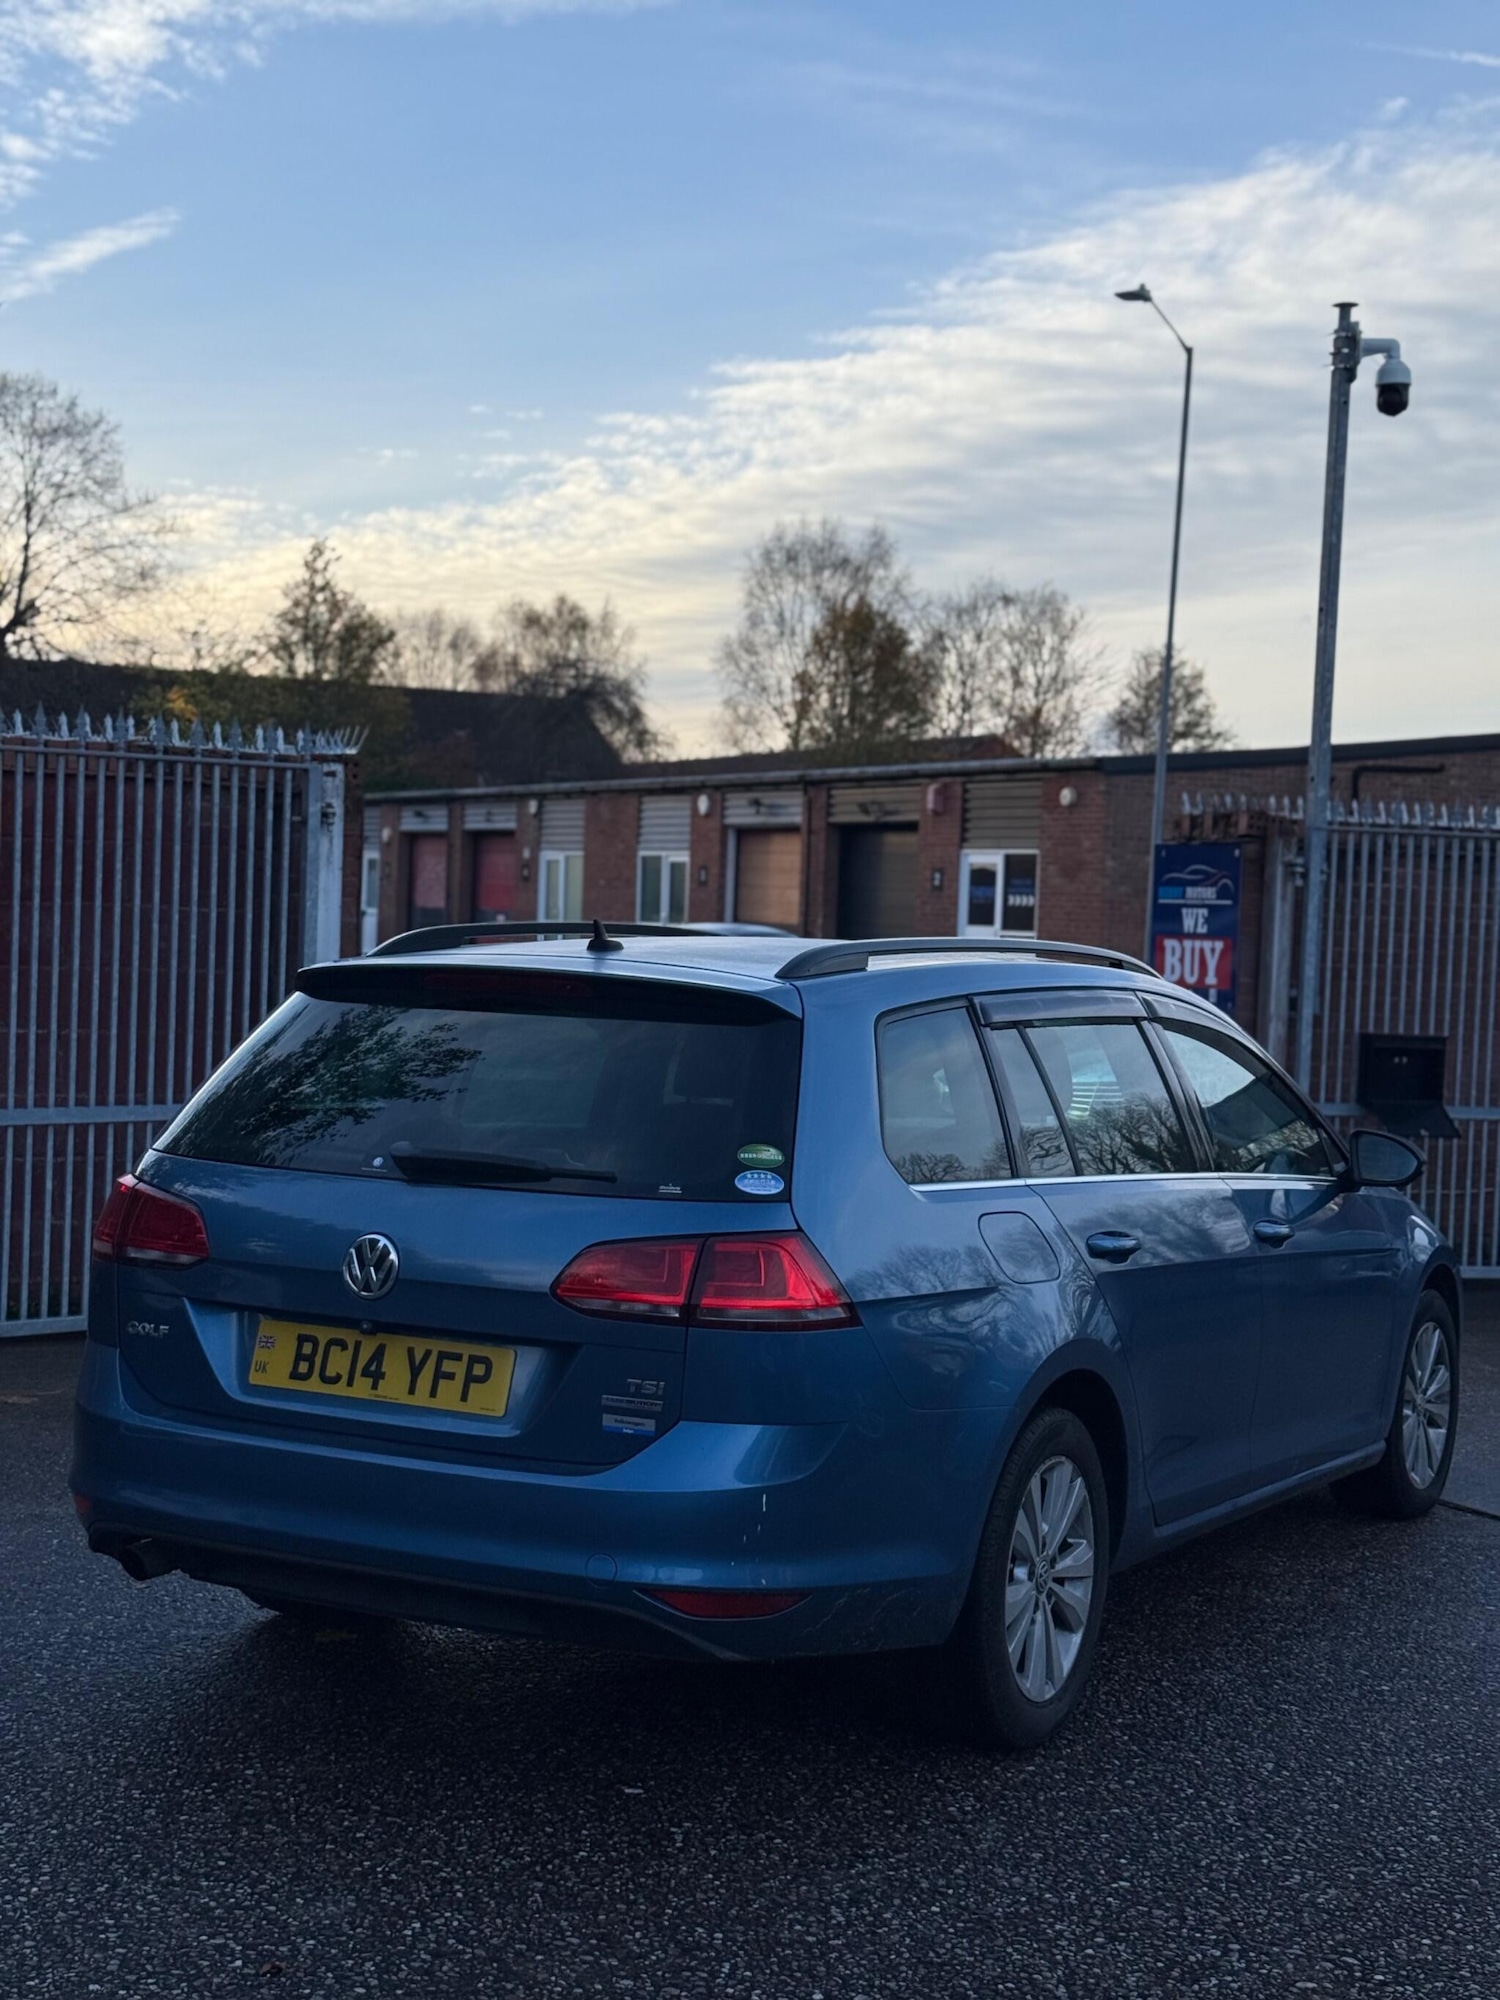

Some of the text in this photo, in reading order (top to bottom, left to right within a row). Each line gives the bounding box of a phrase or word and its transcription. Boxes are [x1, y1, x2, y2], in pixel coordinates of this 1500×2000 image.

[1181, 907, 1209, 934] WE
[1163, 938, 1225, 985] BUY
[127, 1320, 170, 1337] GOLF
[254, 1360, 269, 1374] UK
[288, 1333, 494, 1403] BC14 YFP
